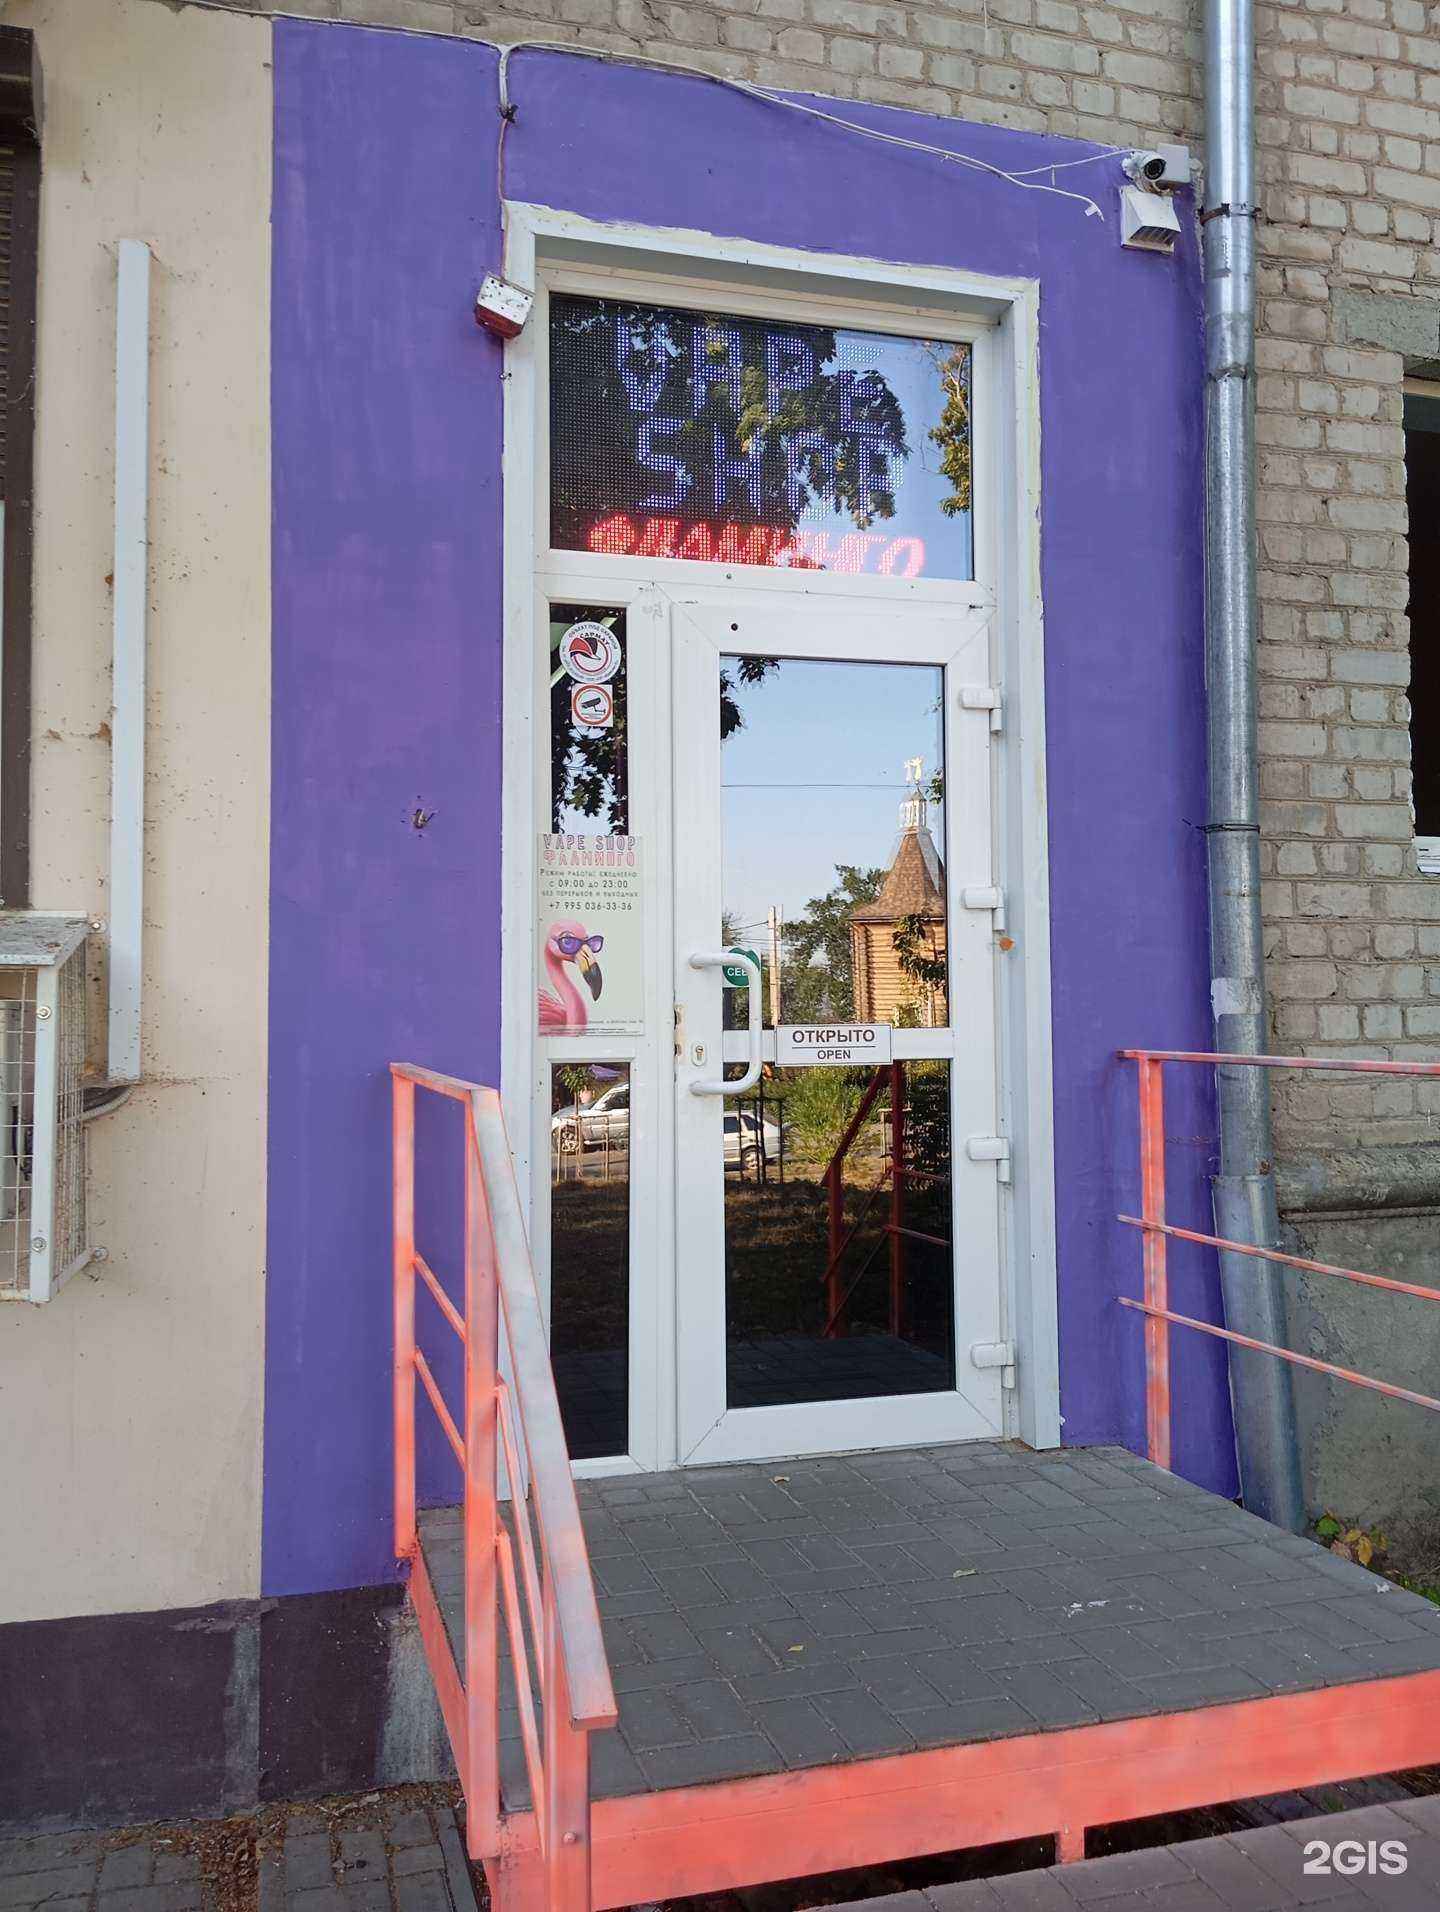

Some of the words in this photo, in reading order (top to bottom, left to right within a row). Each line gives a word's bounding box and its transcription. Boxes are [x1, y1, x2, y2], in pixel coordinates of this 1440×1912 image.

[616, 315, 885, 436] VAPE
[636, 417, 904, 524] SHOP
[588, 515, 926, 577] ФЛАМИНГО
[543, 834, 585, 850] VAPE
[595, 835, 636, 851] SHOP
[543, 850, 635, 866] ФЛАМИНГО
[558, 880, 585, 888] 09:00
[603, 880, 628, 888] 23:00
[564, 902, 581, 910] 995
[585, 902, 632, 911] 036-33-36
[726, 967, 748, 977] СЕБ
[792, 1029, 875, 1044] ОТКРЫТО
[817, 1050, 851, 1060] OPEN
